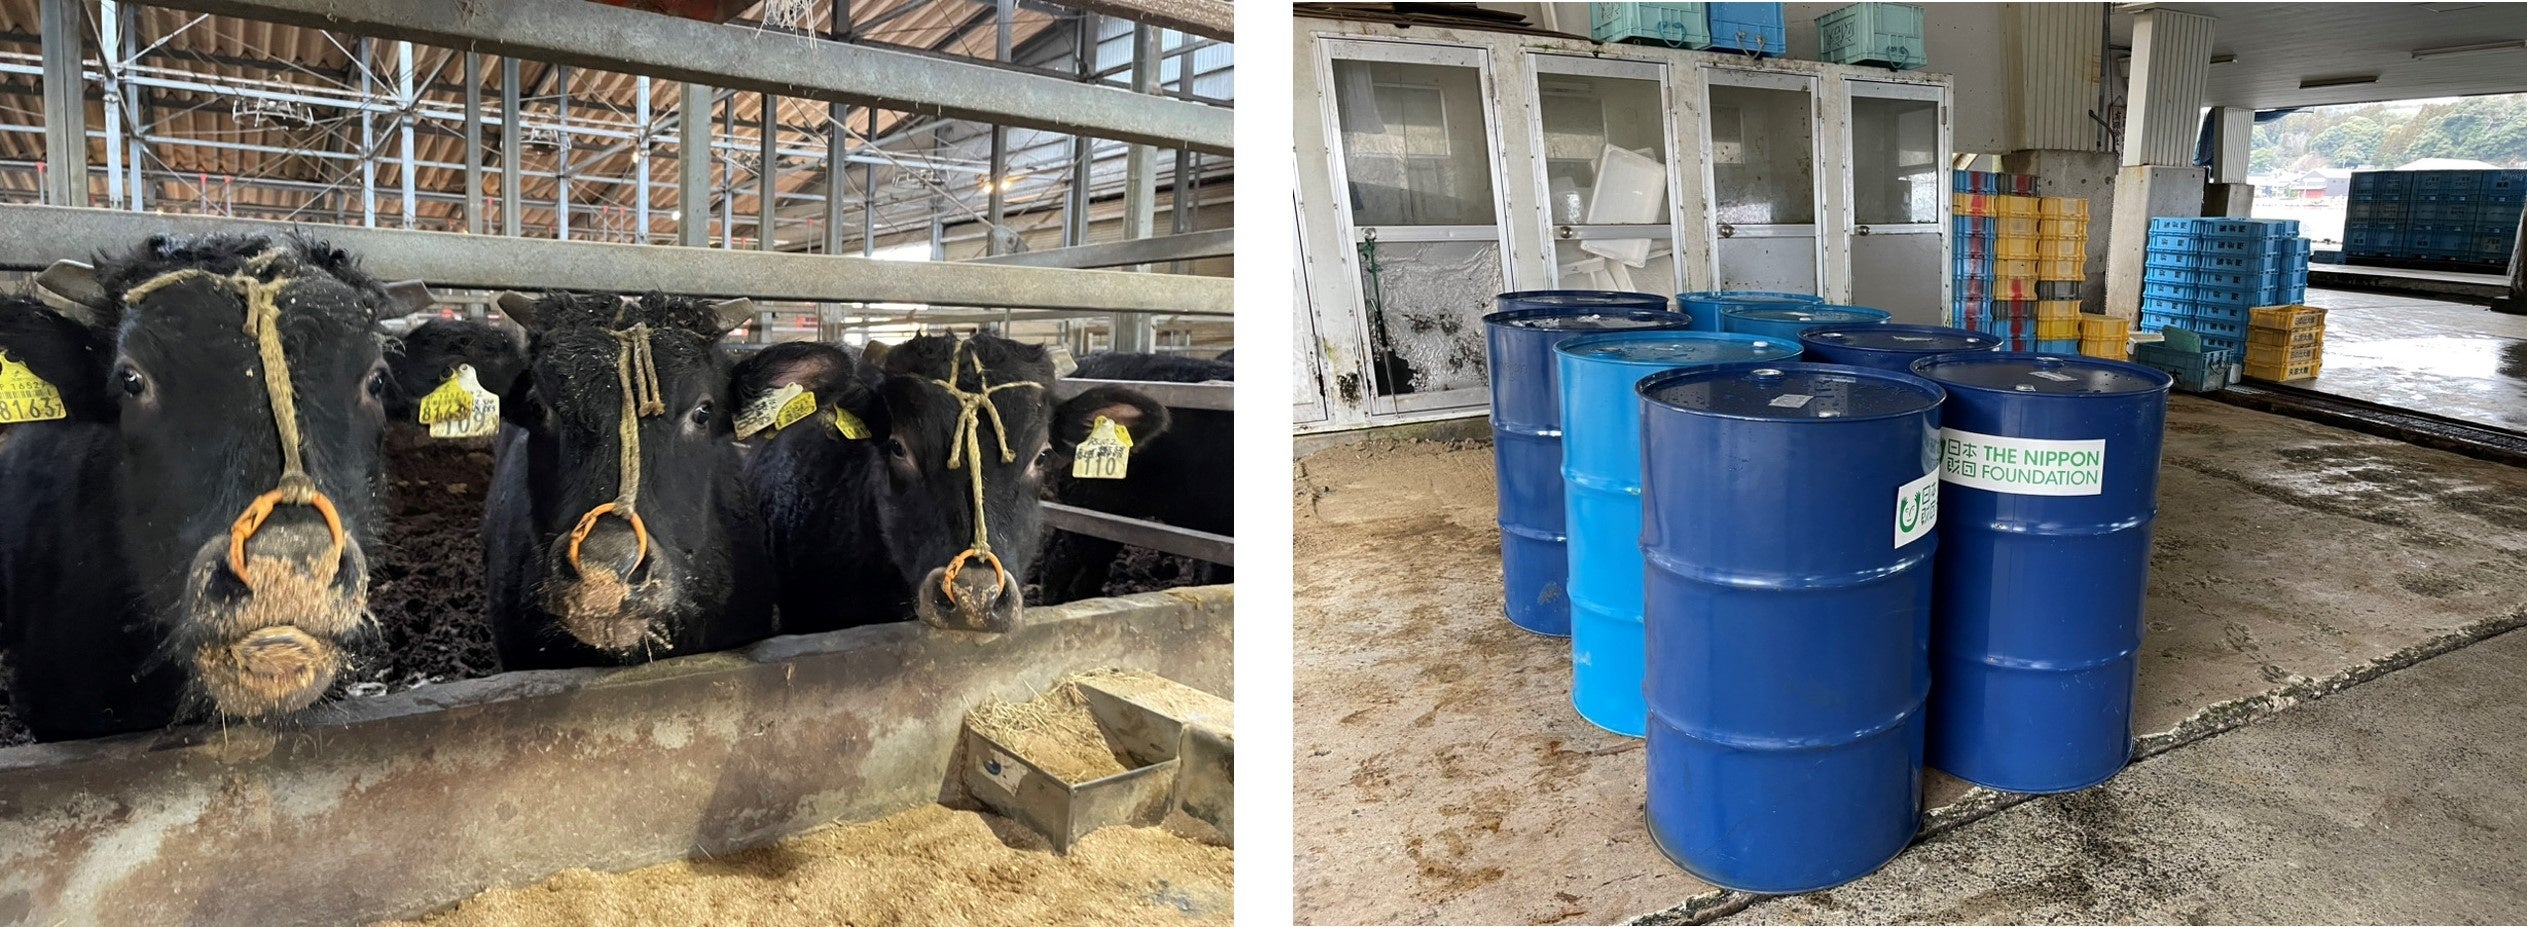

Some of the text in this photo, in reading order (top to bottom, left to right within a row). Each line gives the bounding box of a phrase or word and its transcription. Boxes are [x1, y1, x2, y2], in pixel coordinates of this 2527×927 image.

[1947, 438, 1977, 458] 日本
[1983, 445, 2100, 467] THE NIPPON
[1085, 457, 1116, 476] 110
[1981, 464, 2099, 485] FOUNDATION
